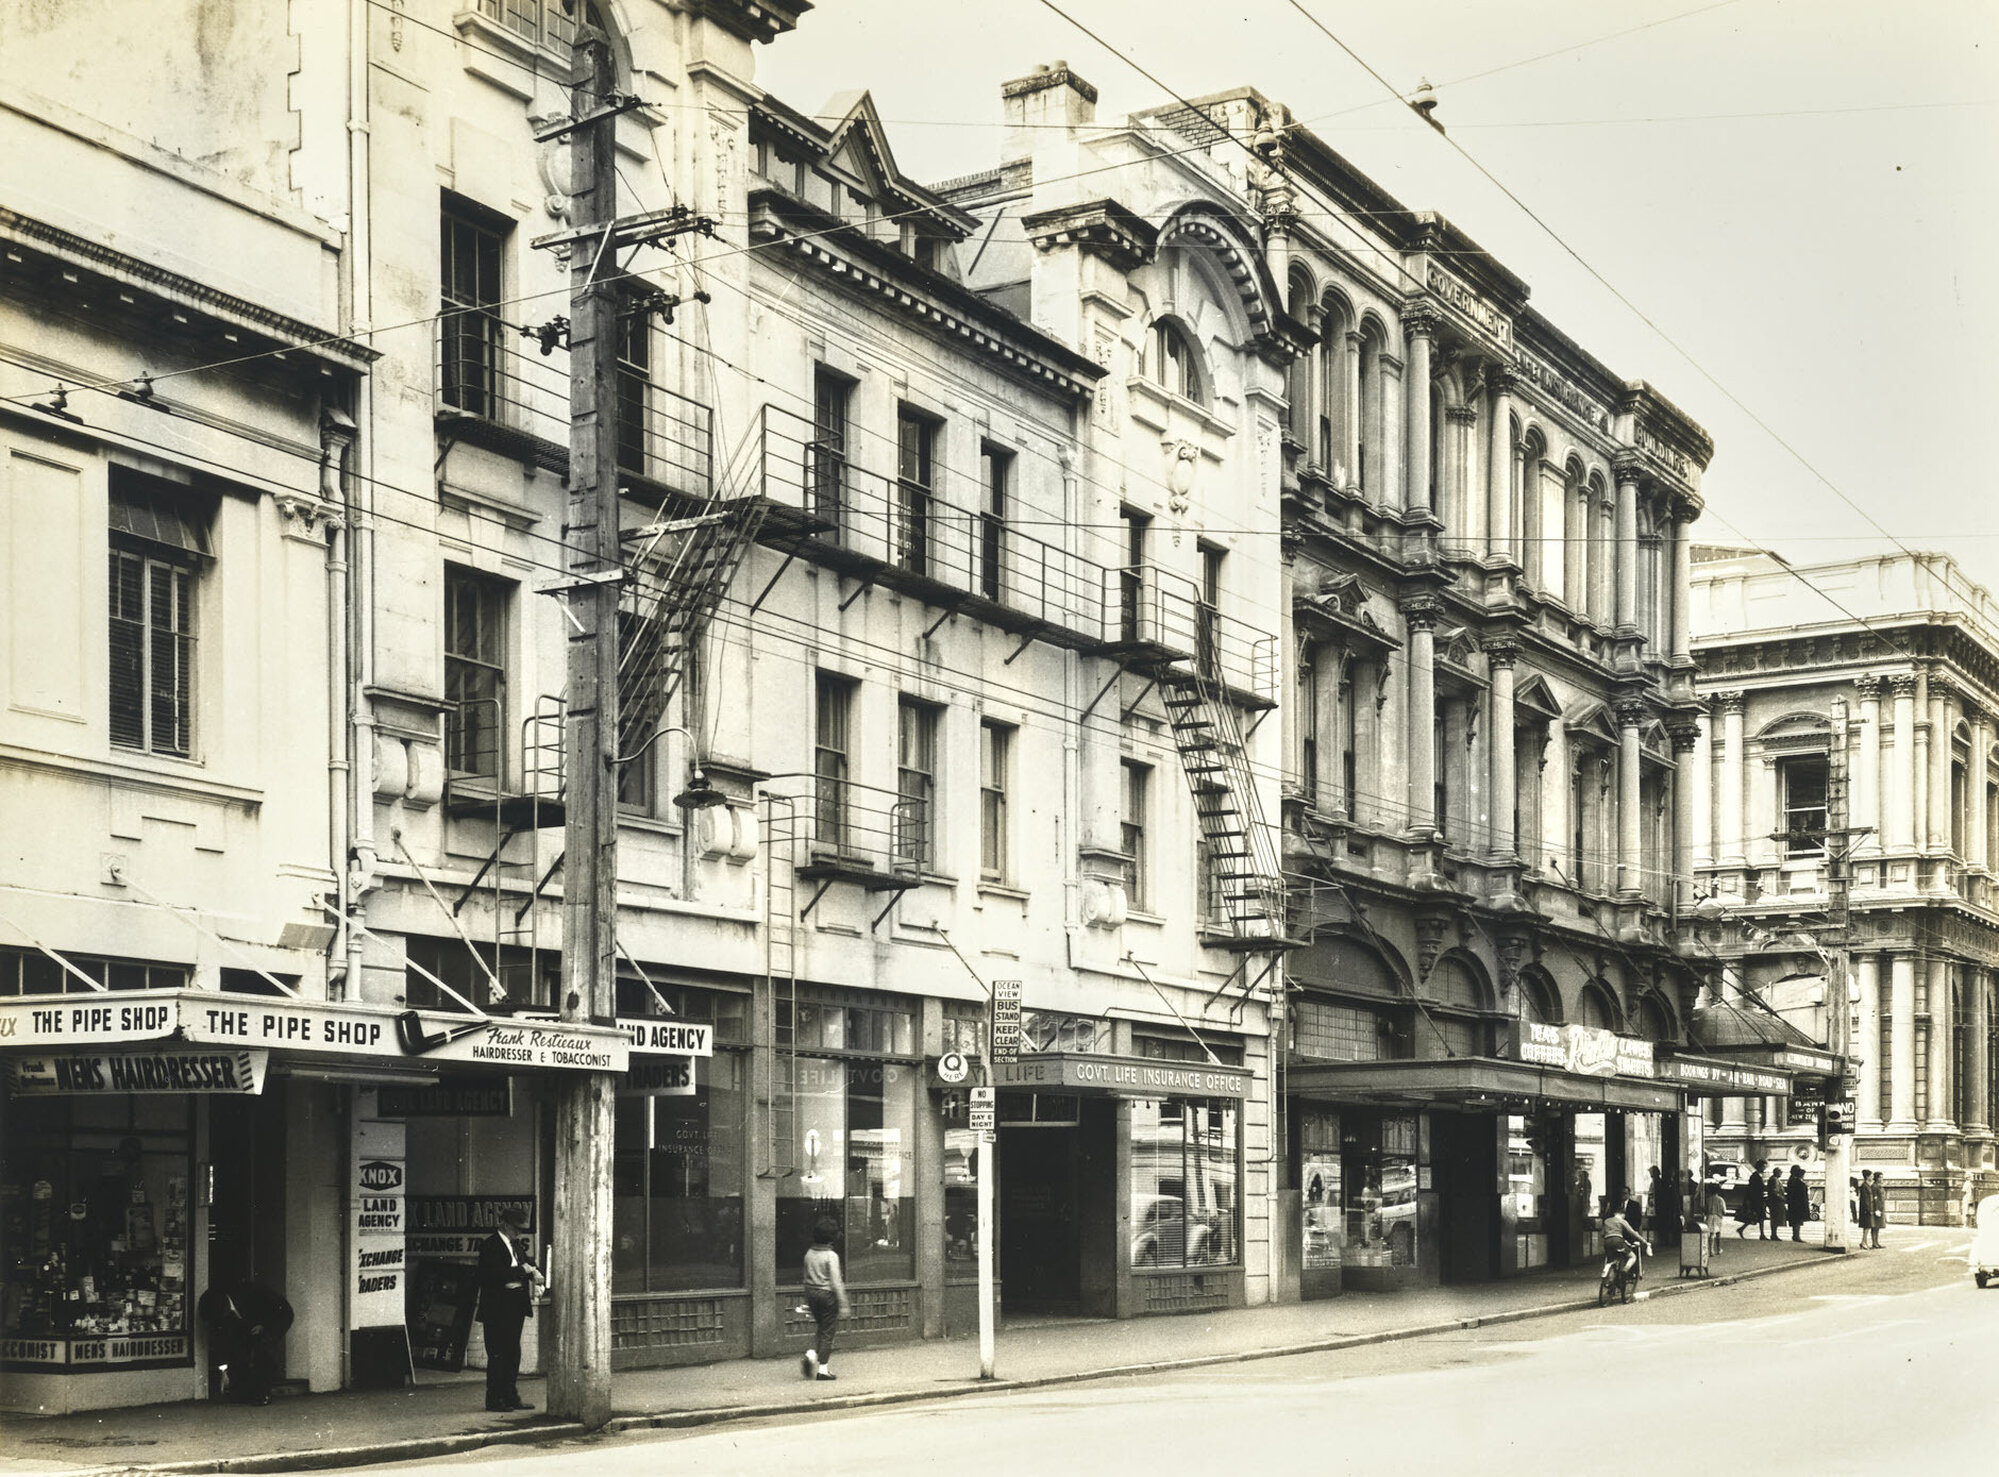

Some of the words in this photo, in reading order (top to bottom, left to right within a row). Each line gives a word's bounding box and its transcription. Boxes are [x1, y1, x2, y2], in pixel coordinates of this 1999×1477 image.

[1427, 267, 1509, 342] GOVERNMENT
[996, 982, 1020, 990] OCEAN
[997, 1001, 1018, 1010] BUS
[32, 1010, 63, 1033] THE
[72, 1008, 112, 1032] PIPE
[121, 1006, 168, 1031] SHOP
[995, 1012, 1020, 1021] STAND
[206, 1010, 249, 1036] THE
[263, 1015, 311, 1041] PIPE
[324, 1020, 381, 1046] SHOP
[995, 1025, 1019, 1035] KEEP
[486, 1027, 525, 1046] Frank
[530, 1030, 591, 1051] Restieaux
[650, 1026, 706, 1050] AGENCY
[994, 1037, 1019, 1046] CLEAR
[472, 1045, 533, 1062] HAIRDRESSER
[552, 1051, 611, 1067] TOBACCONIST
[944, 1054, 961, 1071] Q
[54, 1057, 106, 1090] MENS
[108, 1055, 238, 1089] HAIRDRESSER
[1005, 1065, 1045, 1081] LIFE
[1115, 1065, 1137, 1084] LIFE
[1143, 1069, 1201, 1088] INSURANCE
[1206, 1074, 1242, 1092] OFFICE
[1680, 1063, 1709, 1079] BOOKINGS
[1711, 1068, 1721, 1081] BY
[977, 1090, 987, 1098] NO
[969, 1100, 995, 1109] STOPPING
[1841, 1102, 1855, 1113] NO
[360, 1168, 398, 1185] KNOX
[363, 1199, 397, 1212] LAND
[425, 1201, 468, 1227] LAND
[358, 1214, 400, 1227] AGENCY
[75, 1343, 106, 1360] MENS
[112, 1338, 184, 1358] HAIRDRESSER
